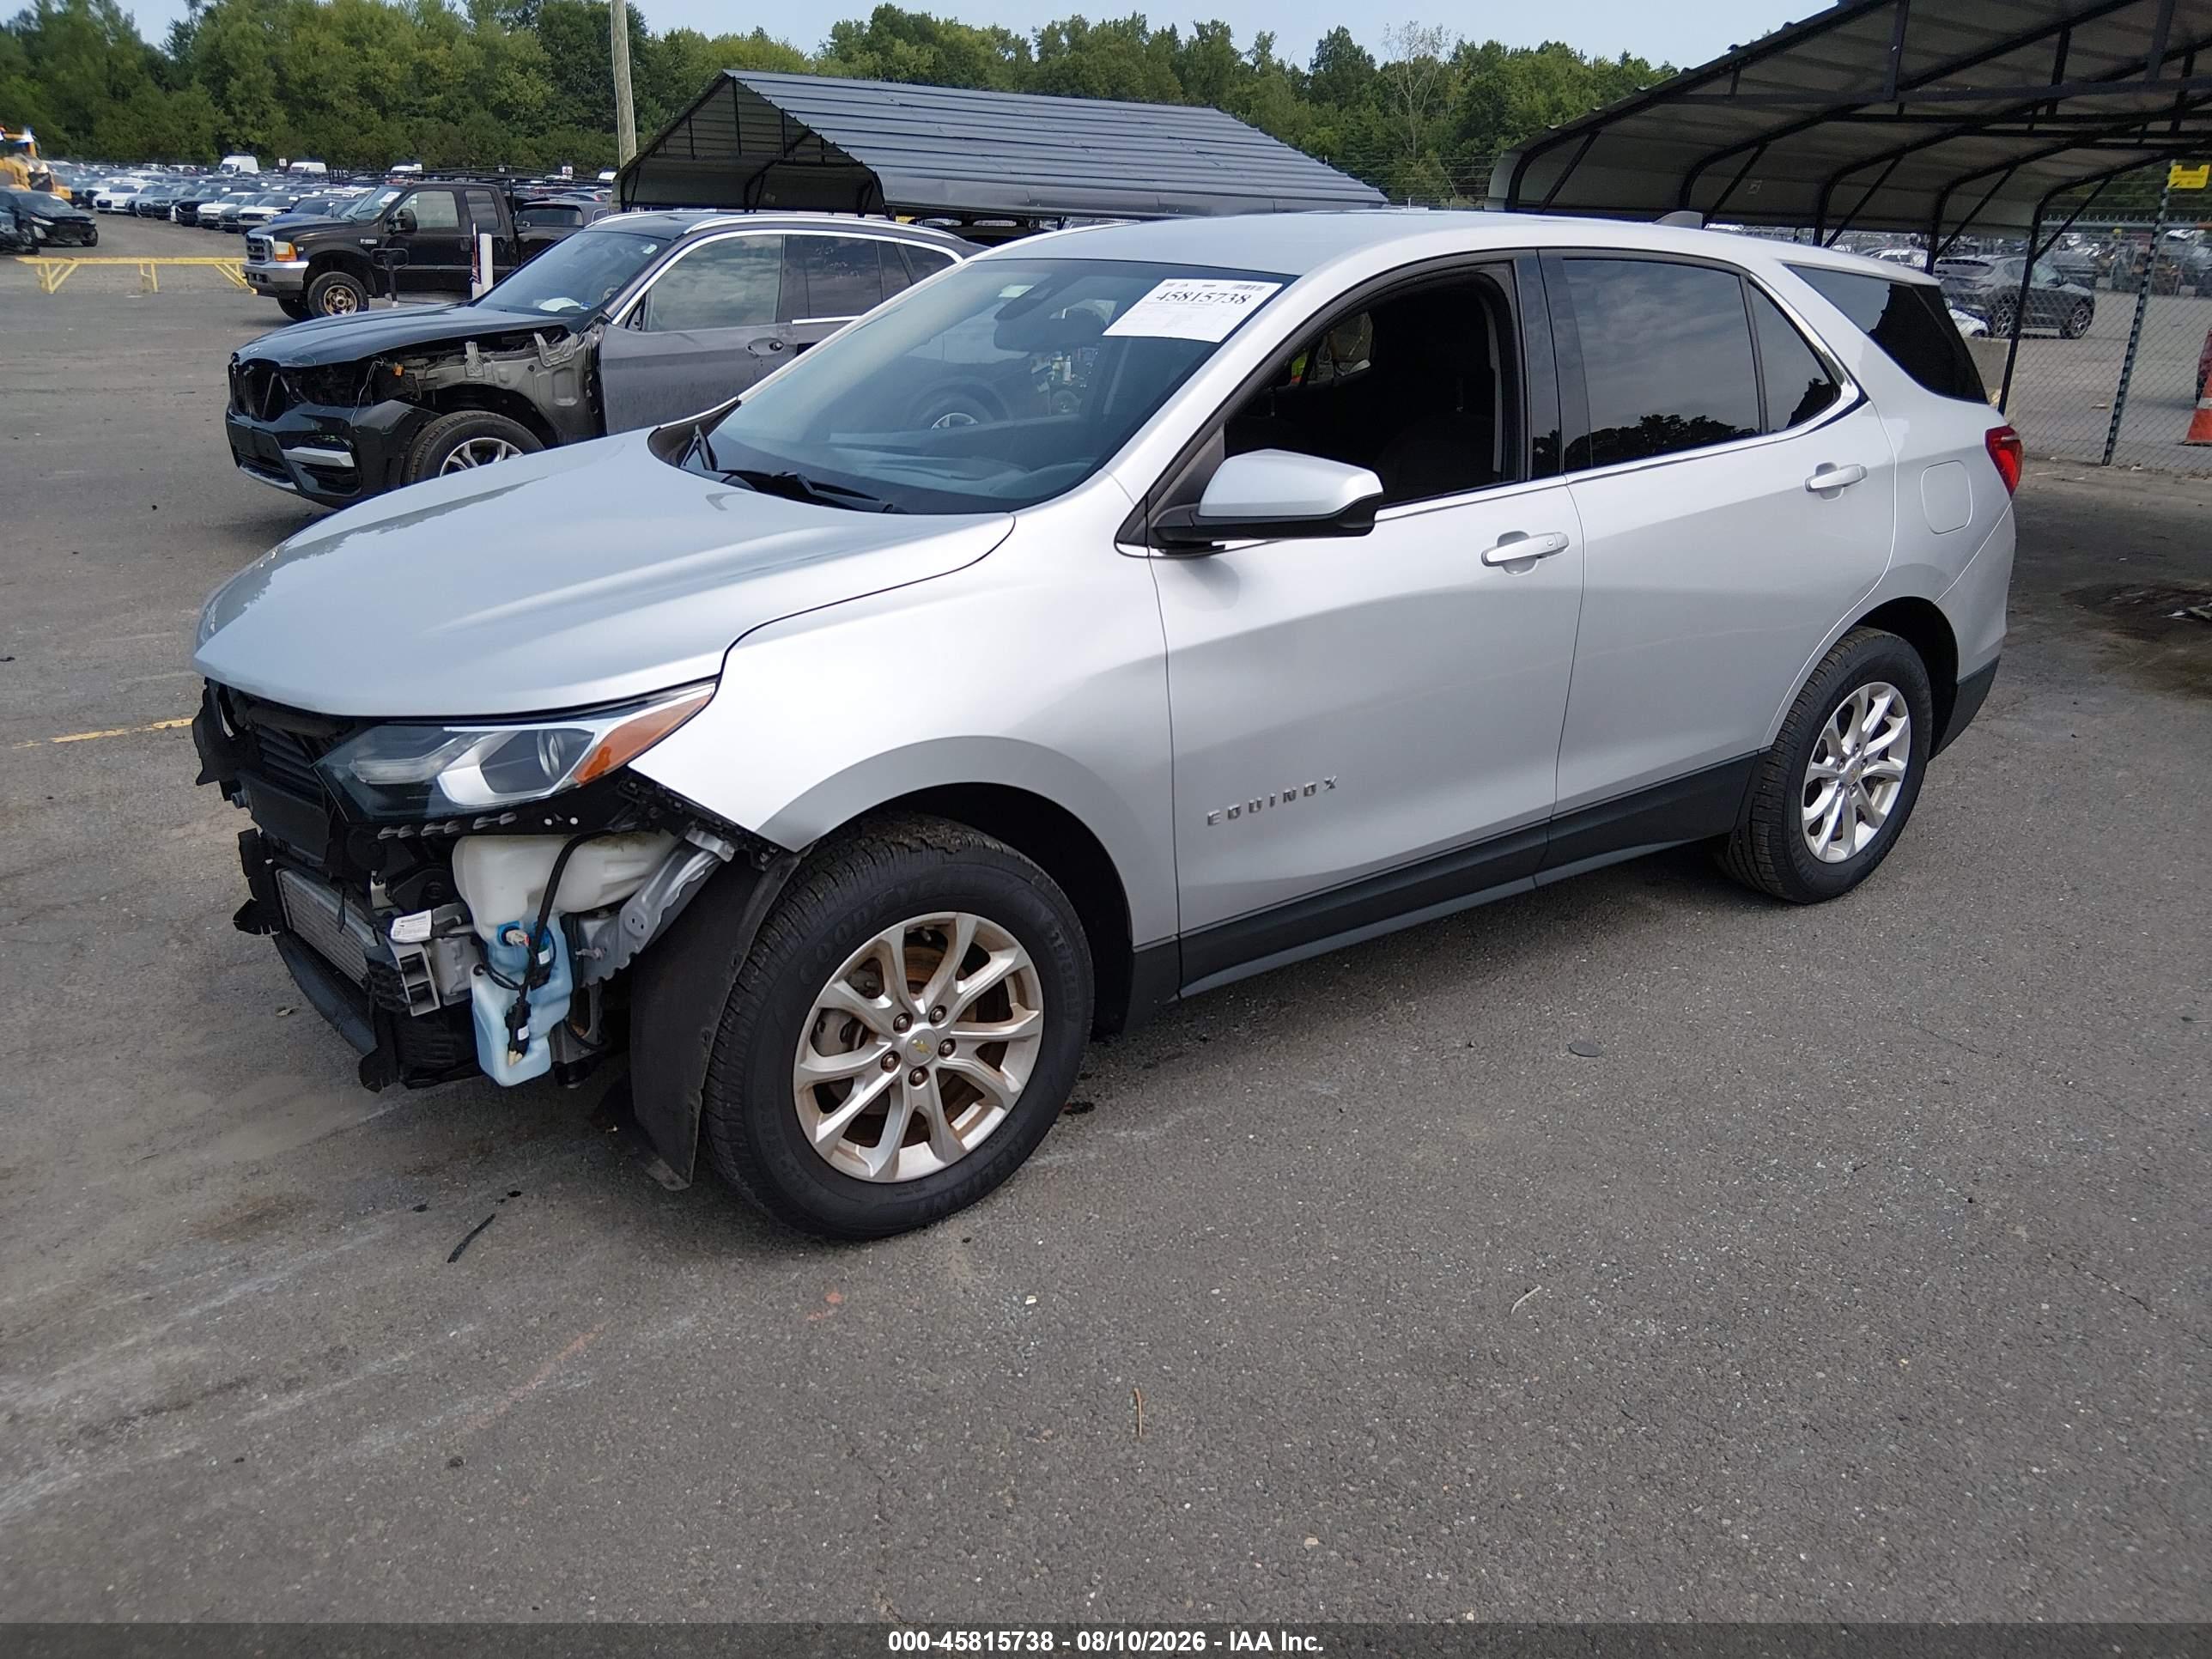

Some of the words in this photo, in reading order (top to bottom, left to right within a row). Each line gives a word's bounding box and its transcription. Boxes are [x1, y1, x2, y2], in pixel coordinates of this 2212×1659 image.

[1155, 290, 1251, 305] 45815738
[1207, 775, 1338, 826] EQUINOX
[791, 875, 977, 987] GOODYEA
